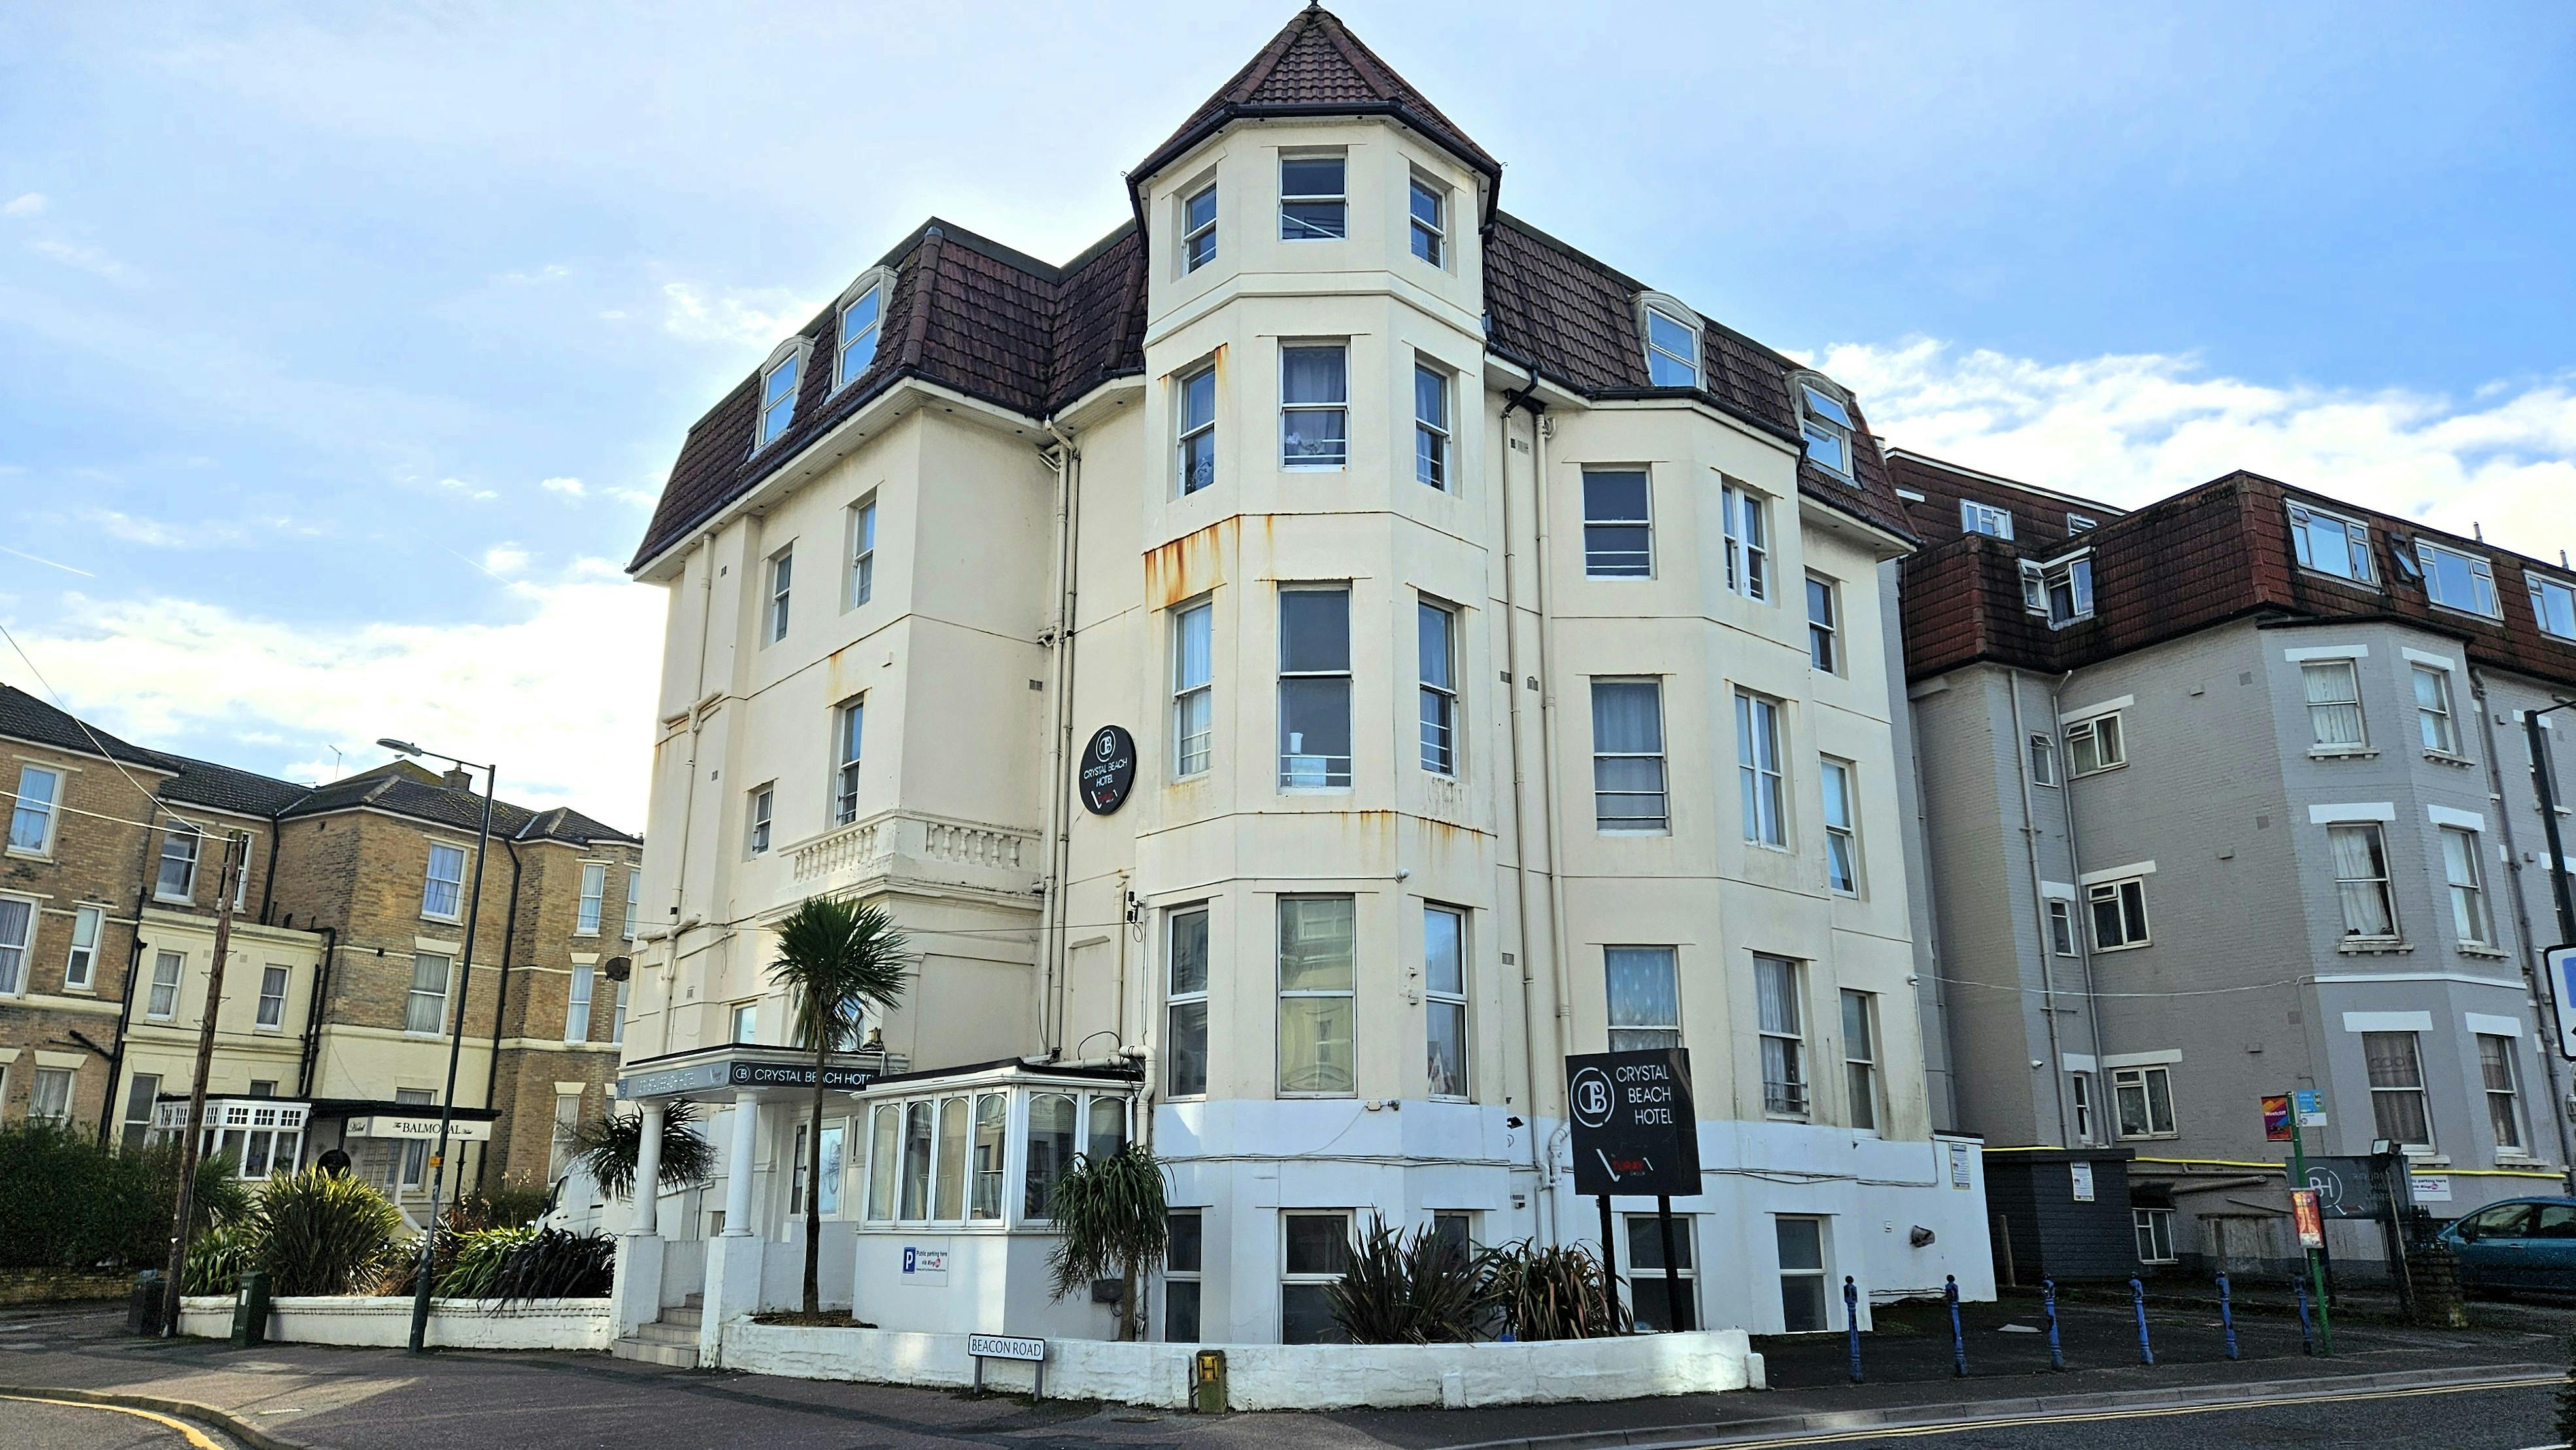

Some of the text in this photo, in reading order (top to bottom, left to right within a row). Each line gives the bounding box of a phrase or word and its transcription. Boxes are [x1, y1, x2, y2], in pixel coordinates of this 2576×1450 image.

[1083, 757, 1128, 779] CRYSTAL BEACH
[1096, 775, 1113, 787] HOTEL
[754, 1068, 874, 1085] CRYSTAL BECH HOTE
[1616, 1065, 1669, 1082] CRYSTAL
[1628, 1087, 1671, 1103] BEACH
[1635, 1109, 1673, 1124] HOTEL
[403, 1122, 460, 1134] BALMOAL
[906, 1251, 913, 1270] P
[972, 1339, 1041, 1357] BEACON ROAD
